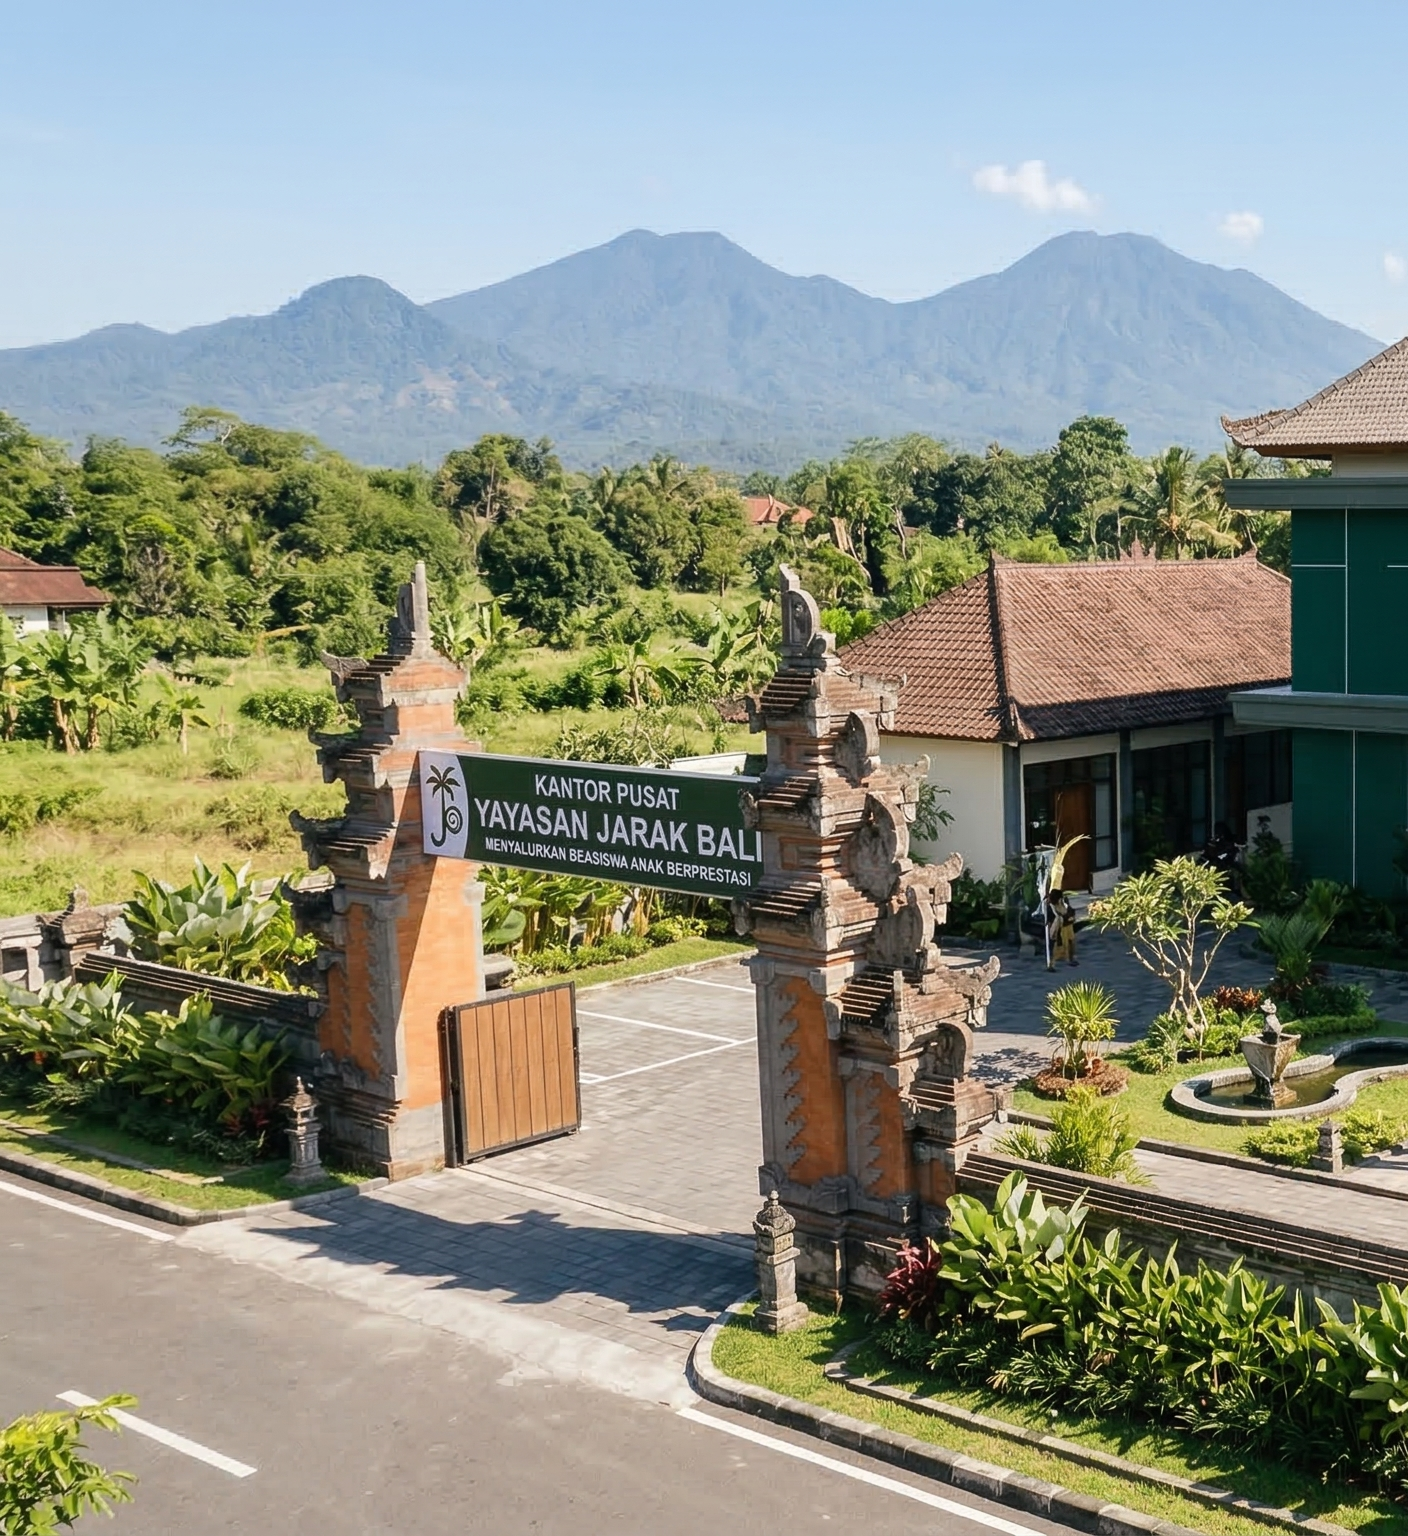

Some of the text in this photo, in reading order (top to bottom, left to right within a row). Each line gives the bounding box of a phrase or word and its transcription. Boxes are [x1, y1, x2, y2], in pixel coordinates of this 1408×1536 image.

[535, 774, 679, 810] KANTOR PUSAT
[474, 798, 762, 863] YAYASAN JARAK BALI
[485, 837, 751, 887] MENYALURKAN BEASISWA ANAK BERPRESTASI
